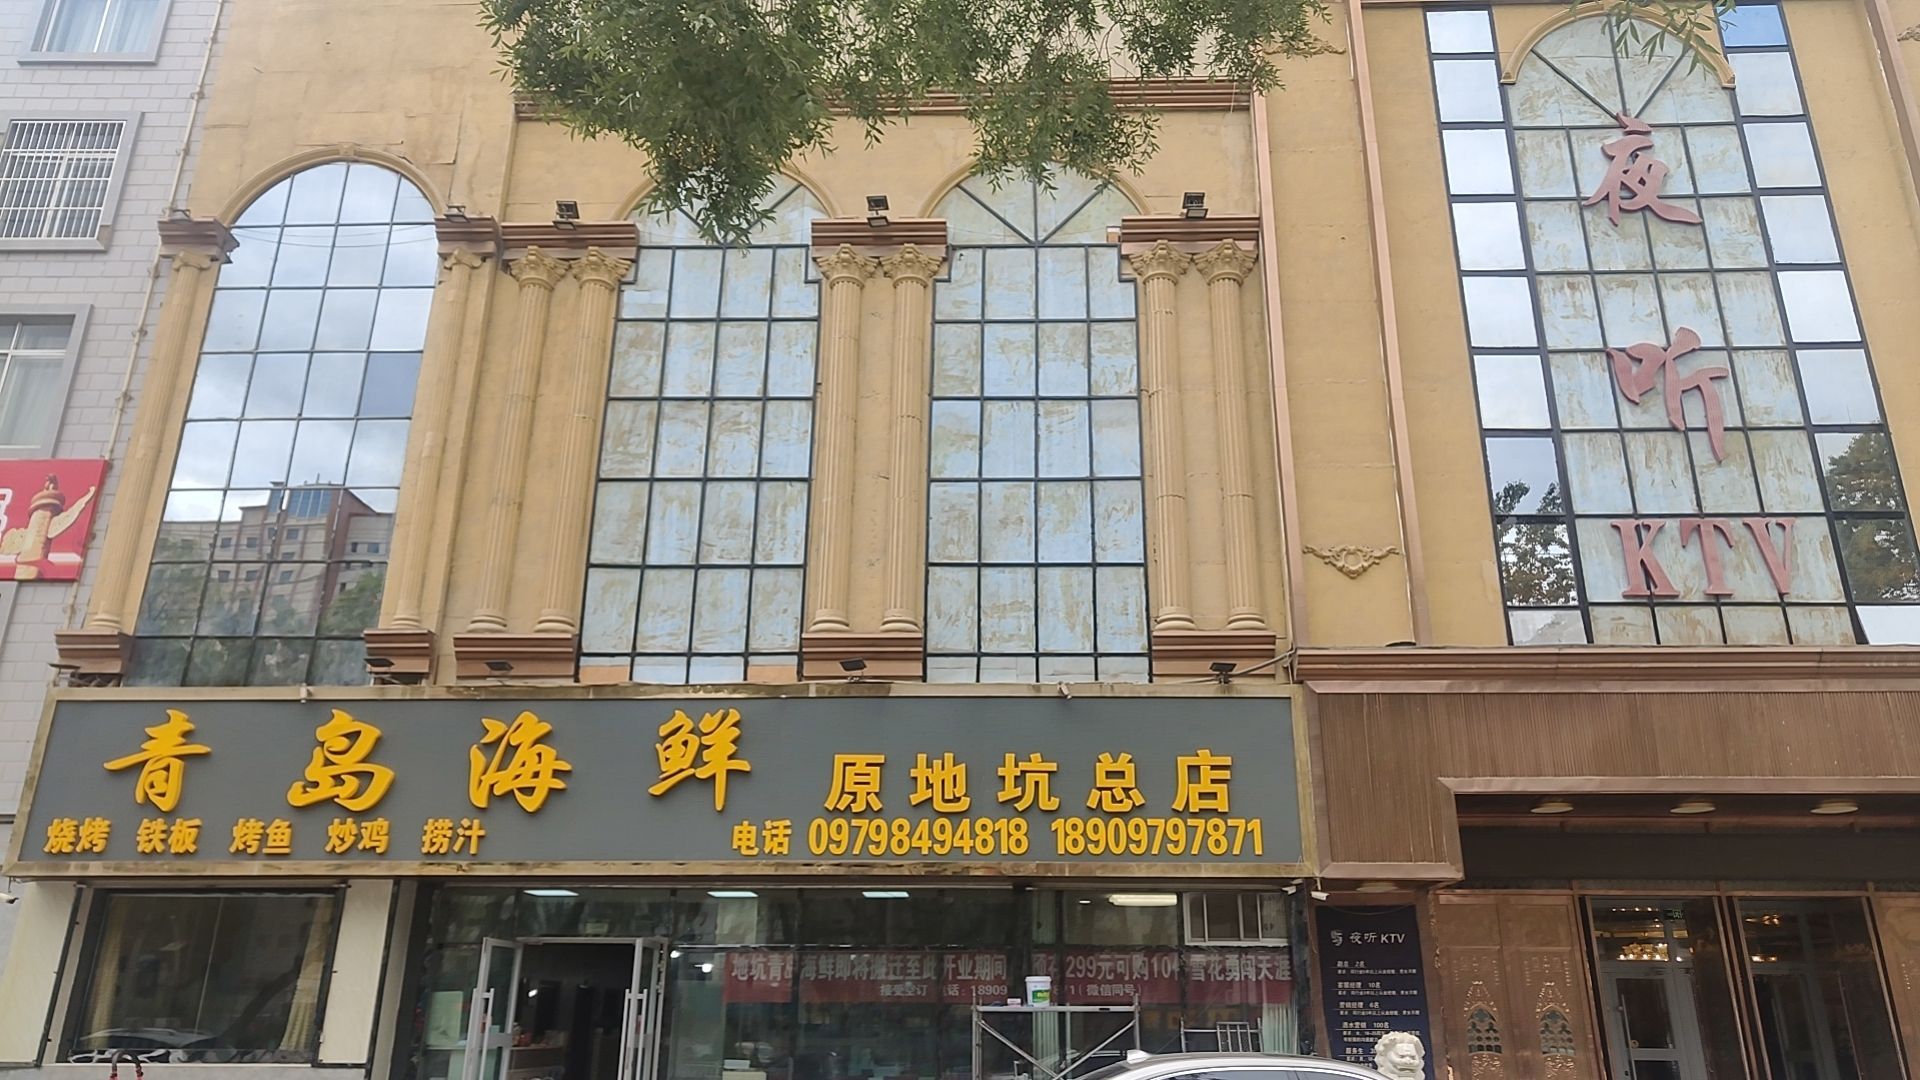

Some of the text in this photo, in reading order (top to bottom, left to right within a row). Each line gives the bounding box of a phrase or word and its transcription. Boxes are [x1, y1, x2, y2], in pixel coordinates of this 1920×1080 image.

[1583, 113, 1731, 464] 夜听
[1611, 518, 1797, 600] KTV
[104, 708, 753, 814] 青岛海鲜
[824, 748, 1233, 814] 原地坑总店
[44, 817, 486, 856] 烧烤 铁板 烤鱼 炒鸡 捞汁
[731, 817, 1263, 857] 电话 09798494818 18909797871
[1348, 931, 1405, 945] 夜听 KTV
